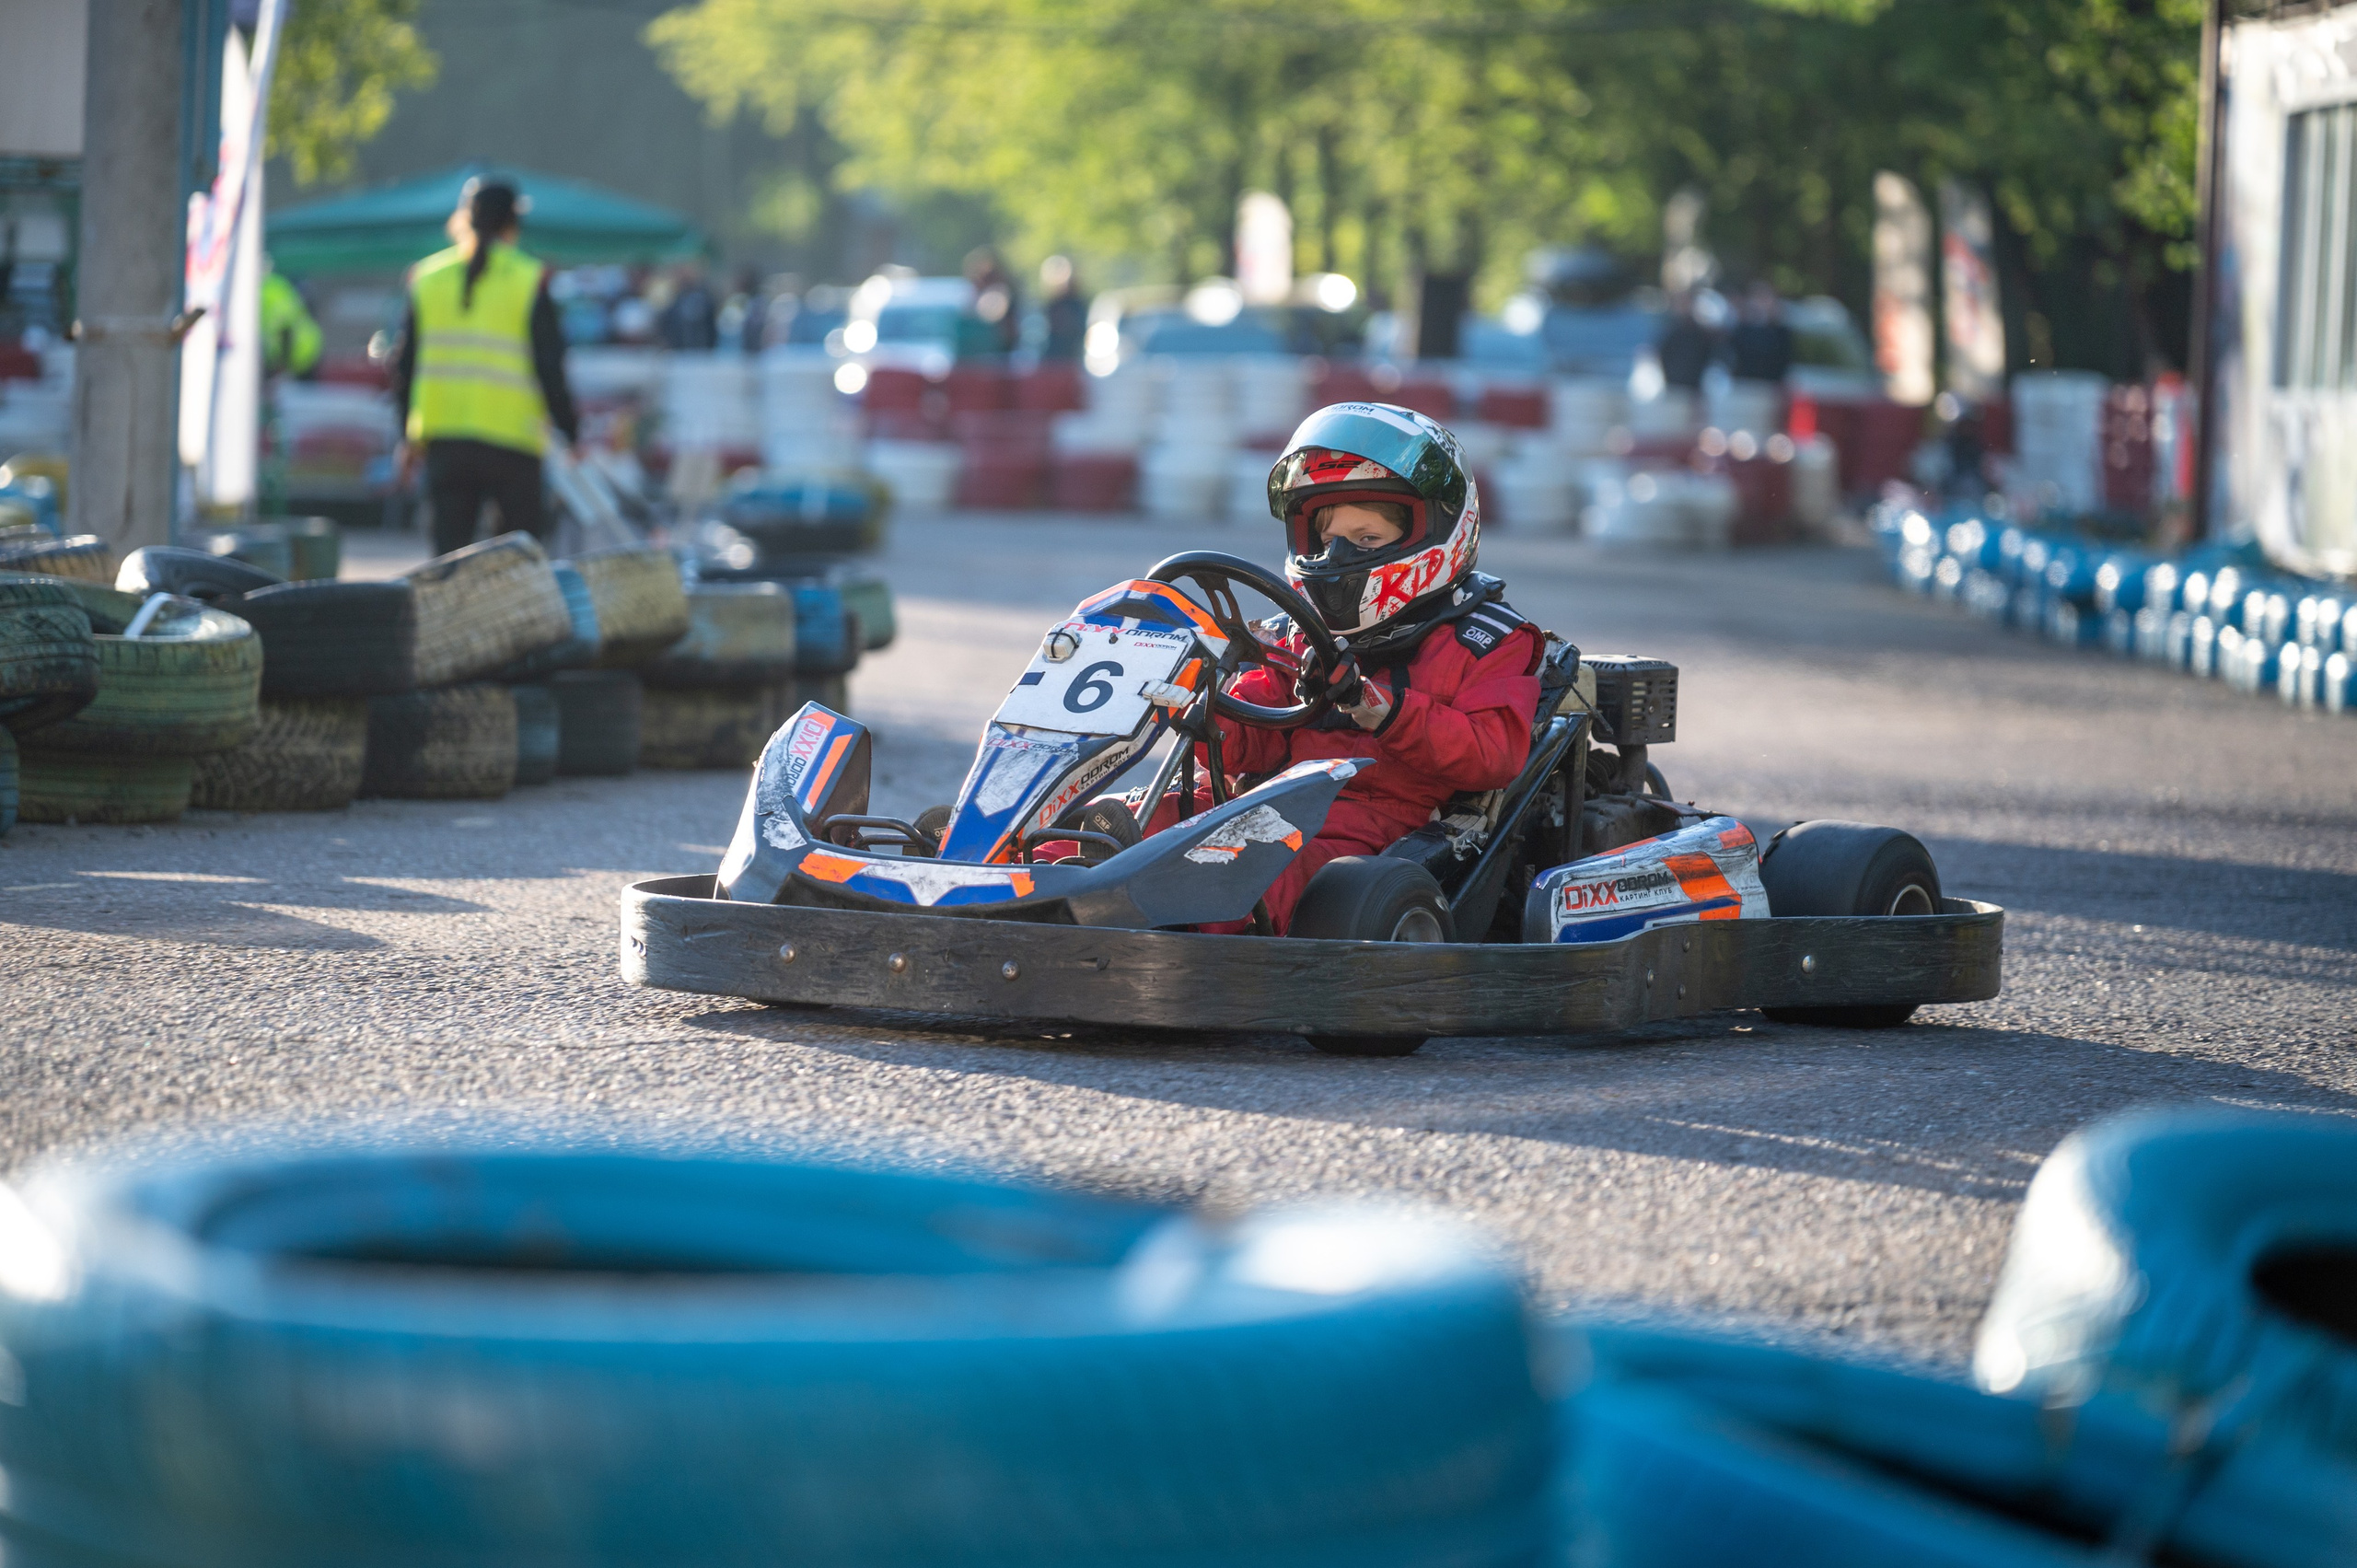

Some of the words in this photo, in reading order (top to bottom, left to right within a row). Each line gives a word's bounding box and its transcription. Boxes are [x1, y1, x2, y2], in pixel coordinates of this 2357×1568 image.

[1302, 460, 1363, 476] LS2
[1465, 628, 1492, 645] OMP
[1062, 660, 1124, 714] 6
[1095, 815, 1110, 830] OMP
[1620, 890, 1652, 902] КАРТИНГ
[1654, 887, 1673, 896] КЛУБ
